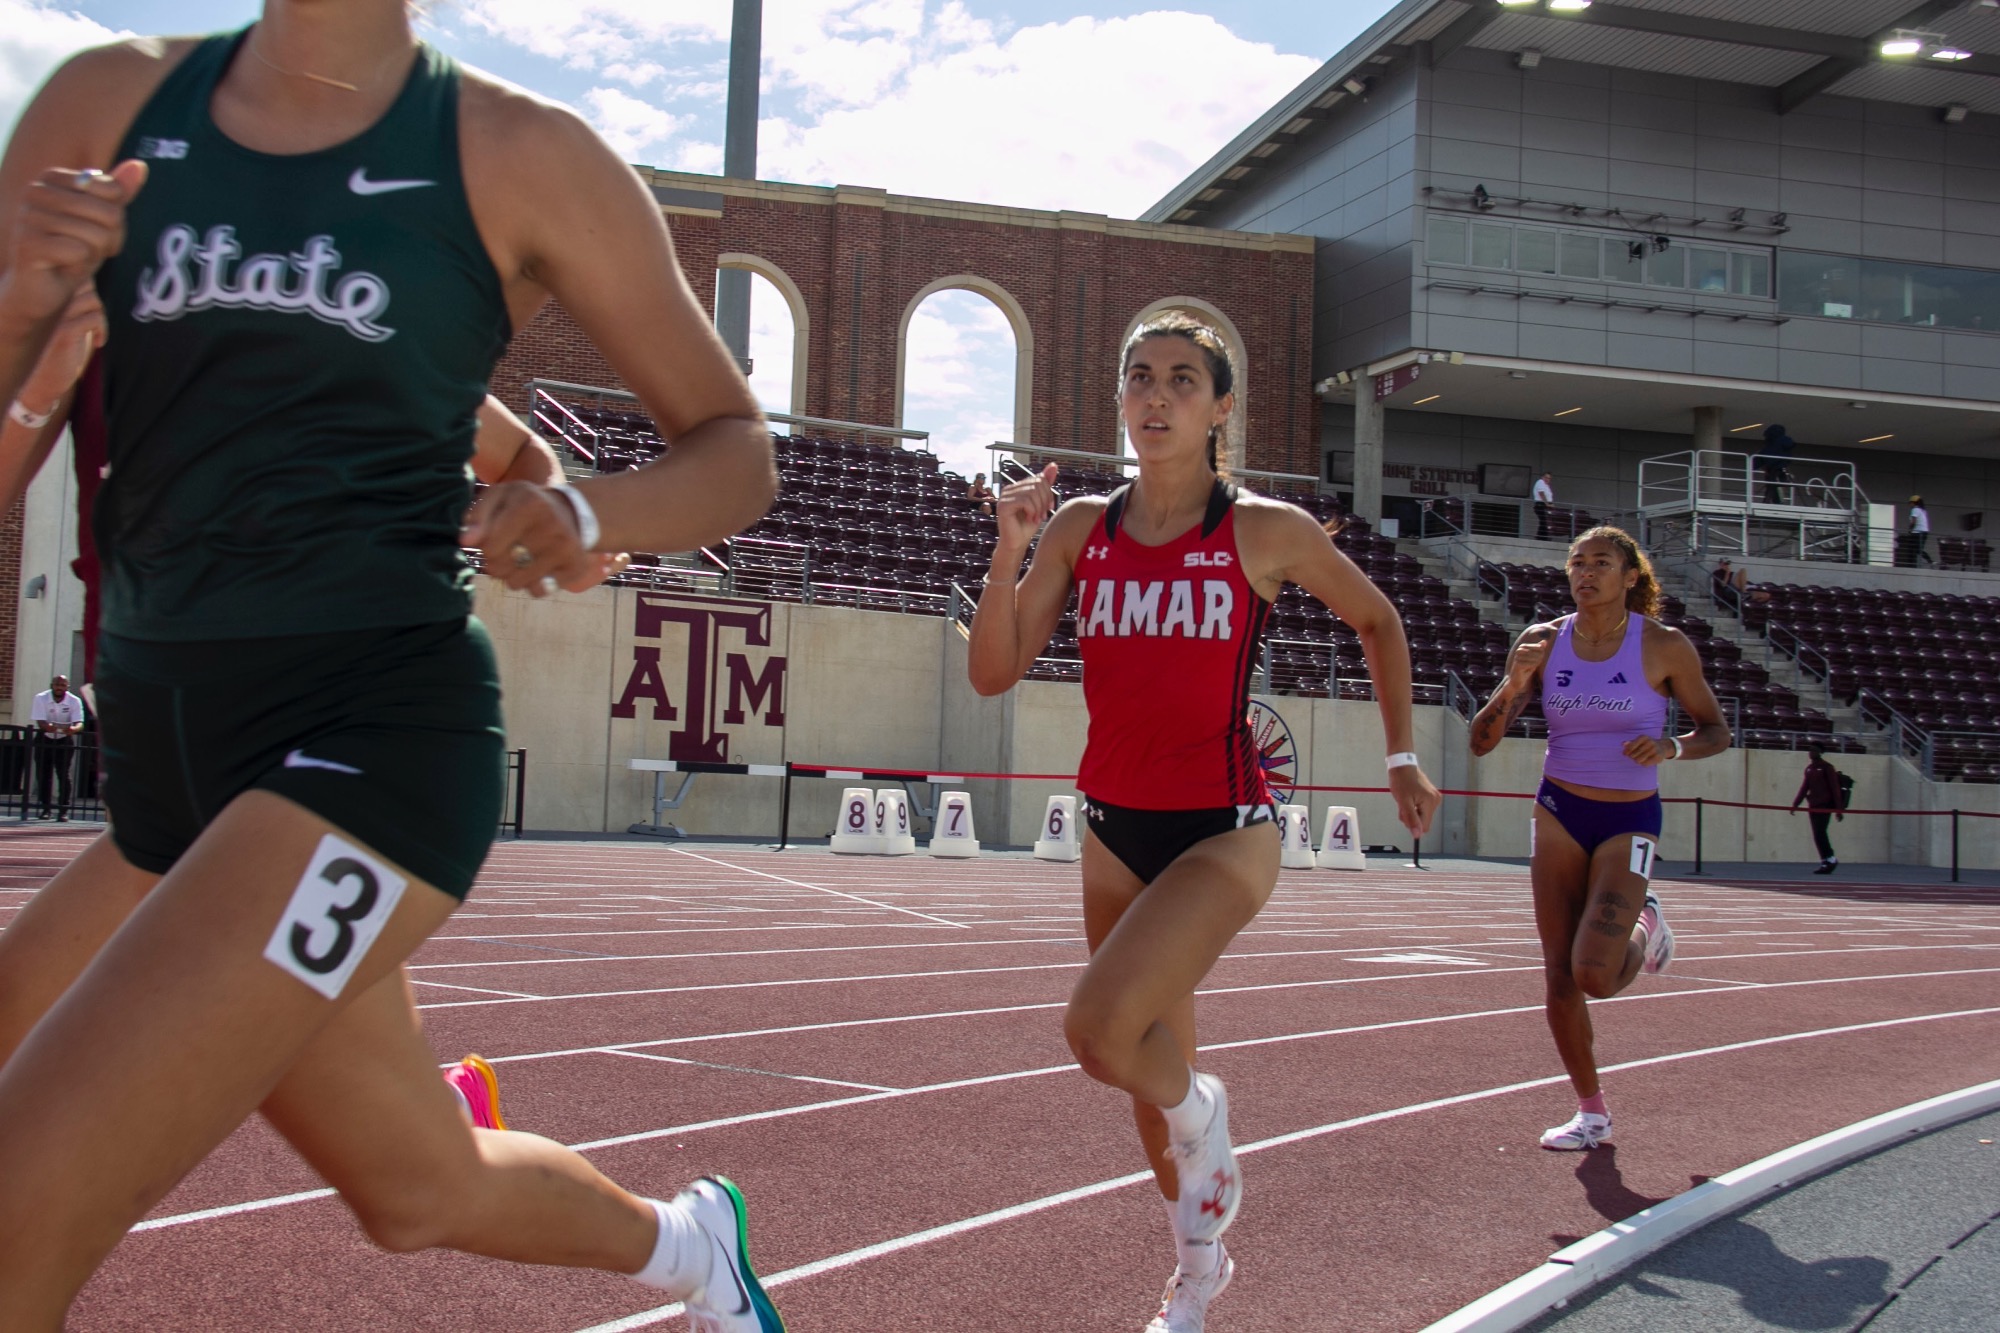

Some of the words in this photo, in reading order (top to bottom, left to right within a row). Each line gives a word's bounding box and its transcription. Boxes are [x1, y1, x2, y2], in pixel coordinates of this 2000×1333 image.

[131, 223, 397, 343] State
[1410, 479, 1449, 497] GRILL
[1076, 578, 1234, 640] LAMAR
[1547, 693, 1583, 717] High
[1585, 694, 1633, 712] Point
[848, 801, 865, 828] 8
[875, 802, 885, 828] 9
[898, 802, 907, 829] 9
[947, 804, 965, 831] 7
[1048, 808, 1064, 835] 6
[1300, 816, 1309, 843] 3
[1333, 819, 1351, 845] 4
[1636, 841, 1650, 874] 1
[290, 856, 381, 975] 3
